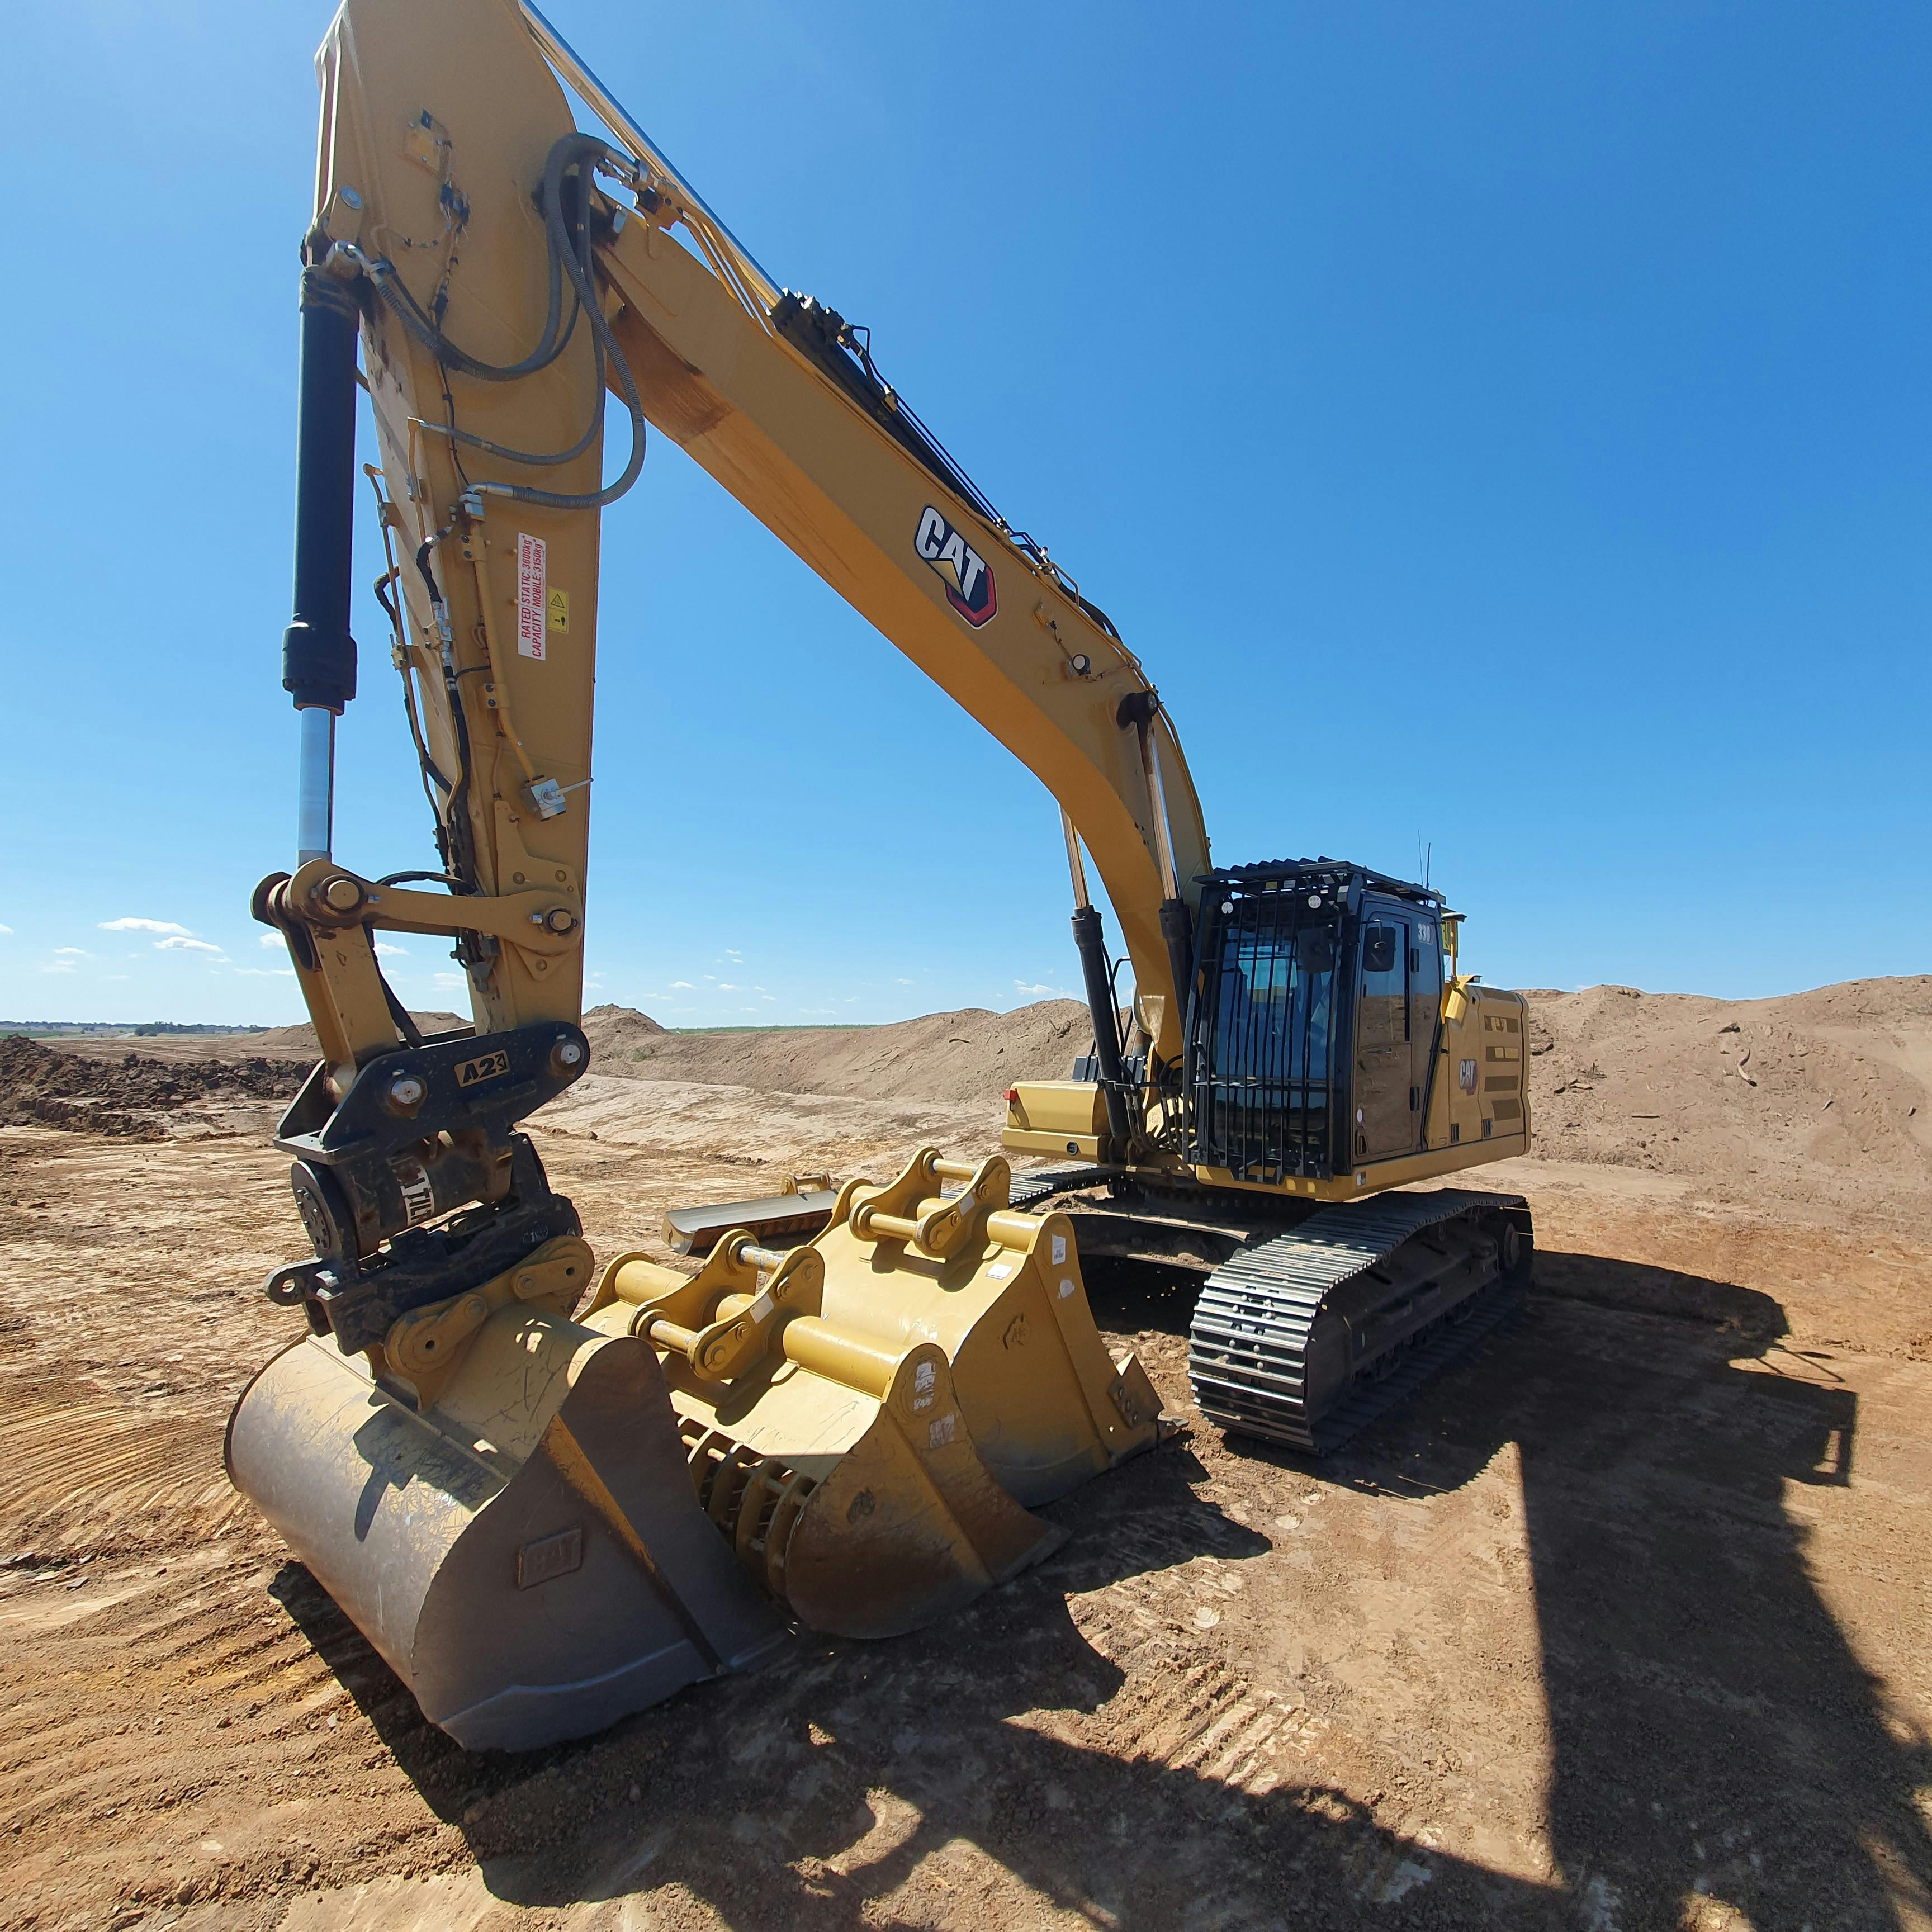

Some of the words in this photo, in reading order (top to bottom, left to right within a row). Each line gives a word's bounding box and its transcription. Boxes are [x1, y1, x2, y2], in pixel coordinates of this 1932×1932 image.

[916, 508, 986, 602] CAT
[521, 570, 531, 604] STATIC:
[532, 572, 542, 608] MOBILE:
[521, 607, 531, 639] RATED
[532, 610, 541, 657] CAPACITY
[1418, 923, 1431, 943] 330
[1460, 1060, 1475, 1088] CAT
